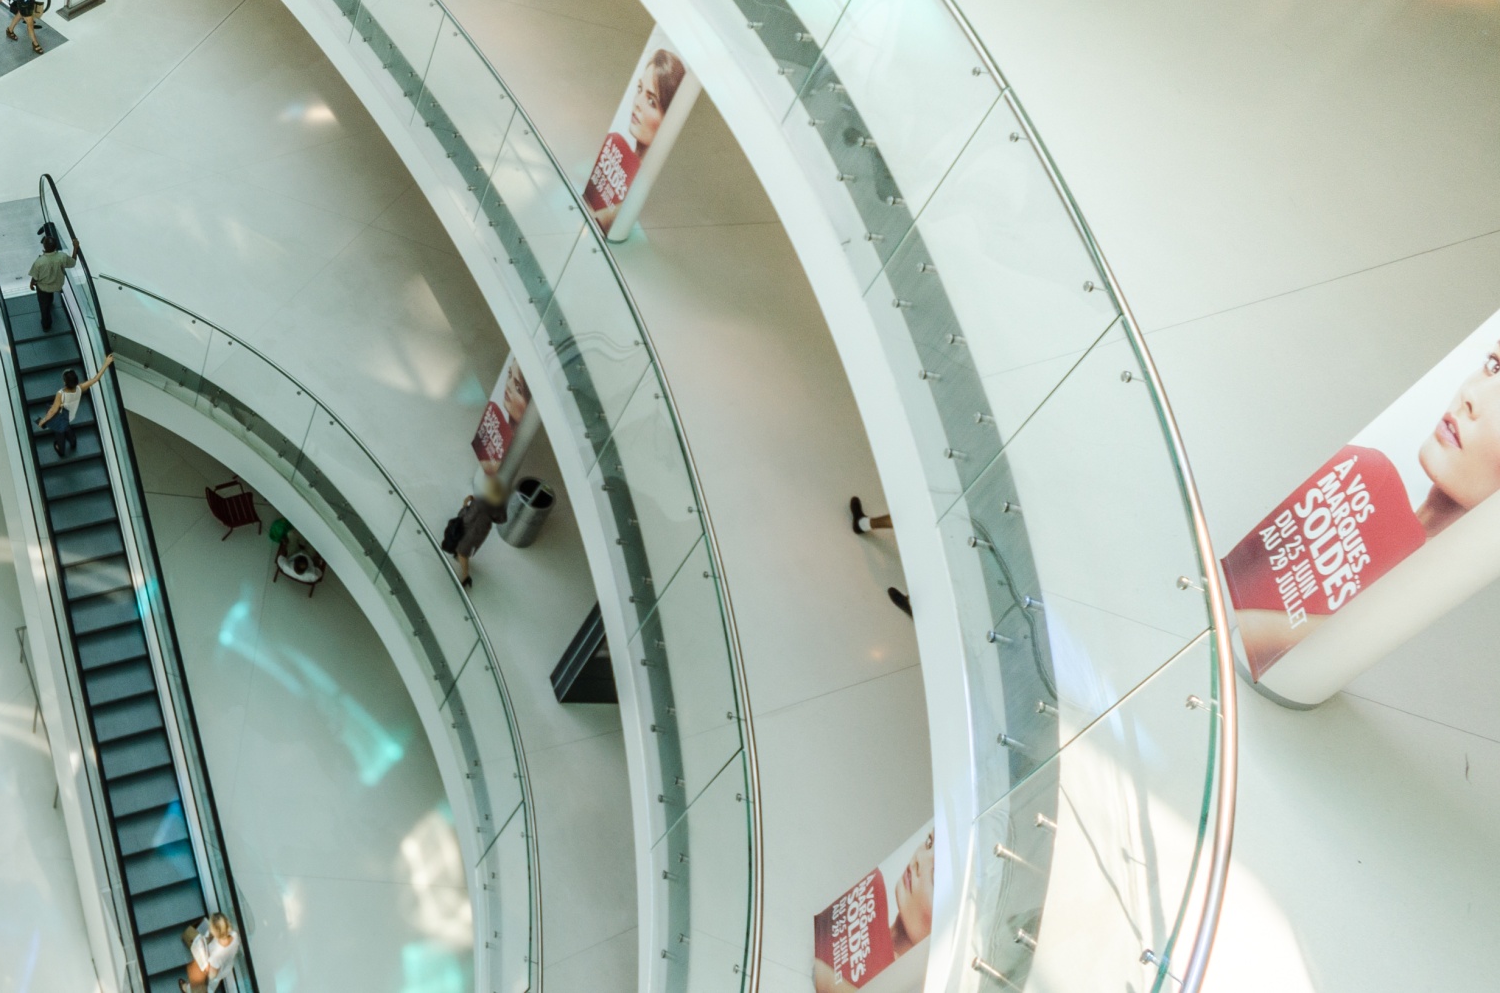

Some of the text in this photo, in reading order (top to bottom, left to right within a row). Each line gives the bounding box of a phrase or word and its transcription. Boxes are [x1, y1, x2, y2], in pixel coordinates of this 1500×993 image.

[598, 153, 628, 201] SOLDES
[1316, 471, 1372, 590] MARQUES...
[1333, 454, 1376, 524] À VOS
[1258, 524, 1308, 630] AU 29 JUILLET
[1274, 509, 1319, 600] DU 25 JUIN
[1293, 487, 1358, 611] SOLDES
[831, 904, 843, 986] AU 29 JUILLET
[838, 896, 849, 966] DU 25 JUIN
[847, 886, 866, 983] SOLDES
[866, 886, 877, 923] VOS
